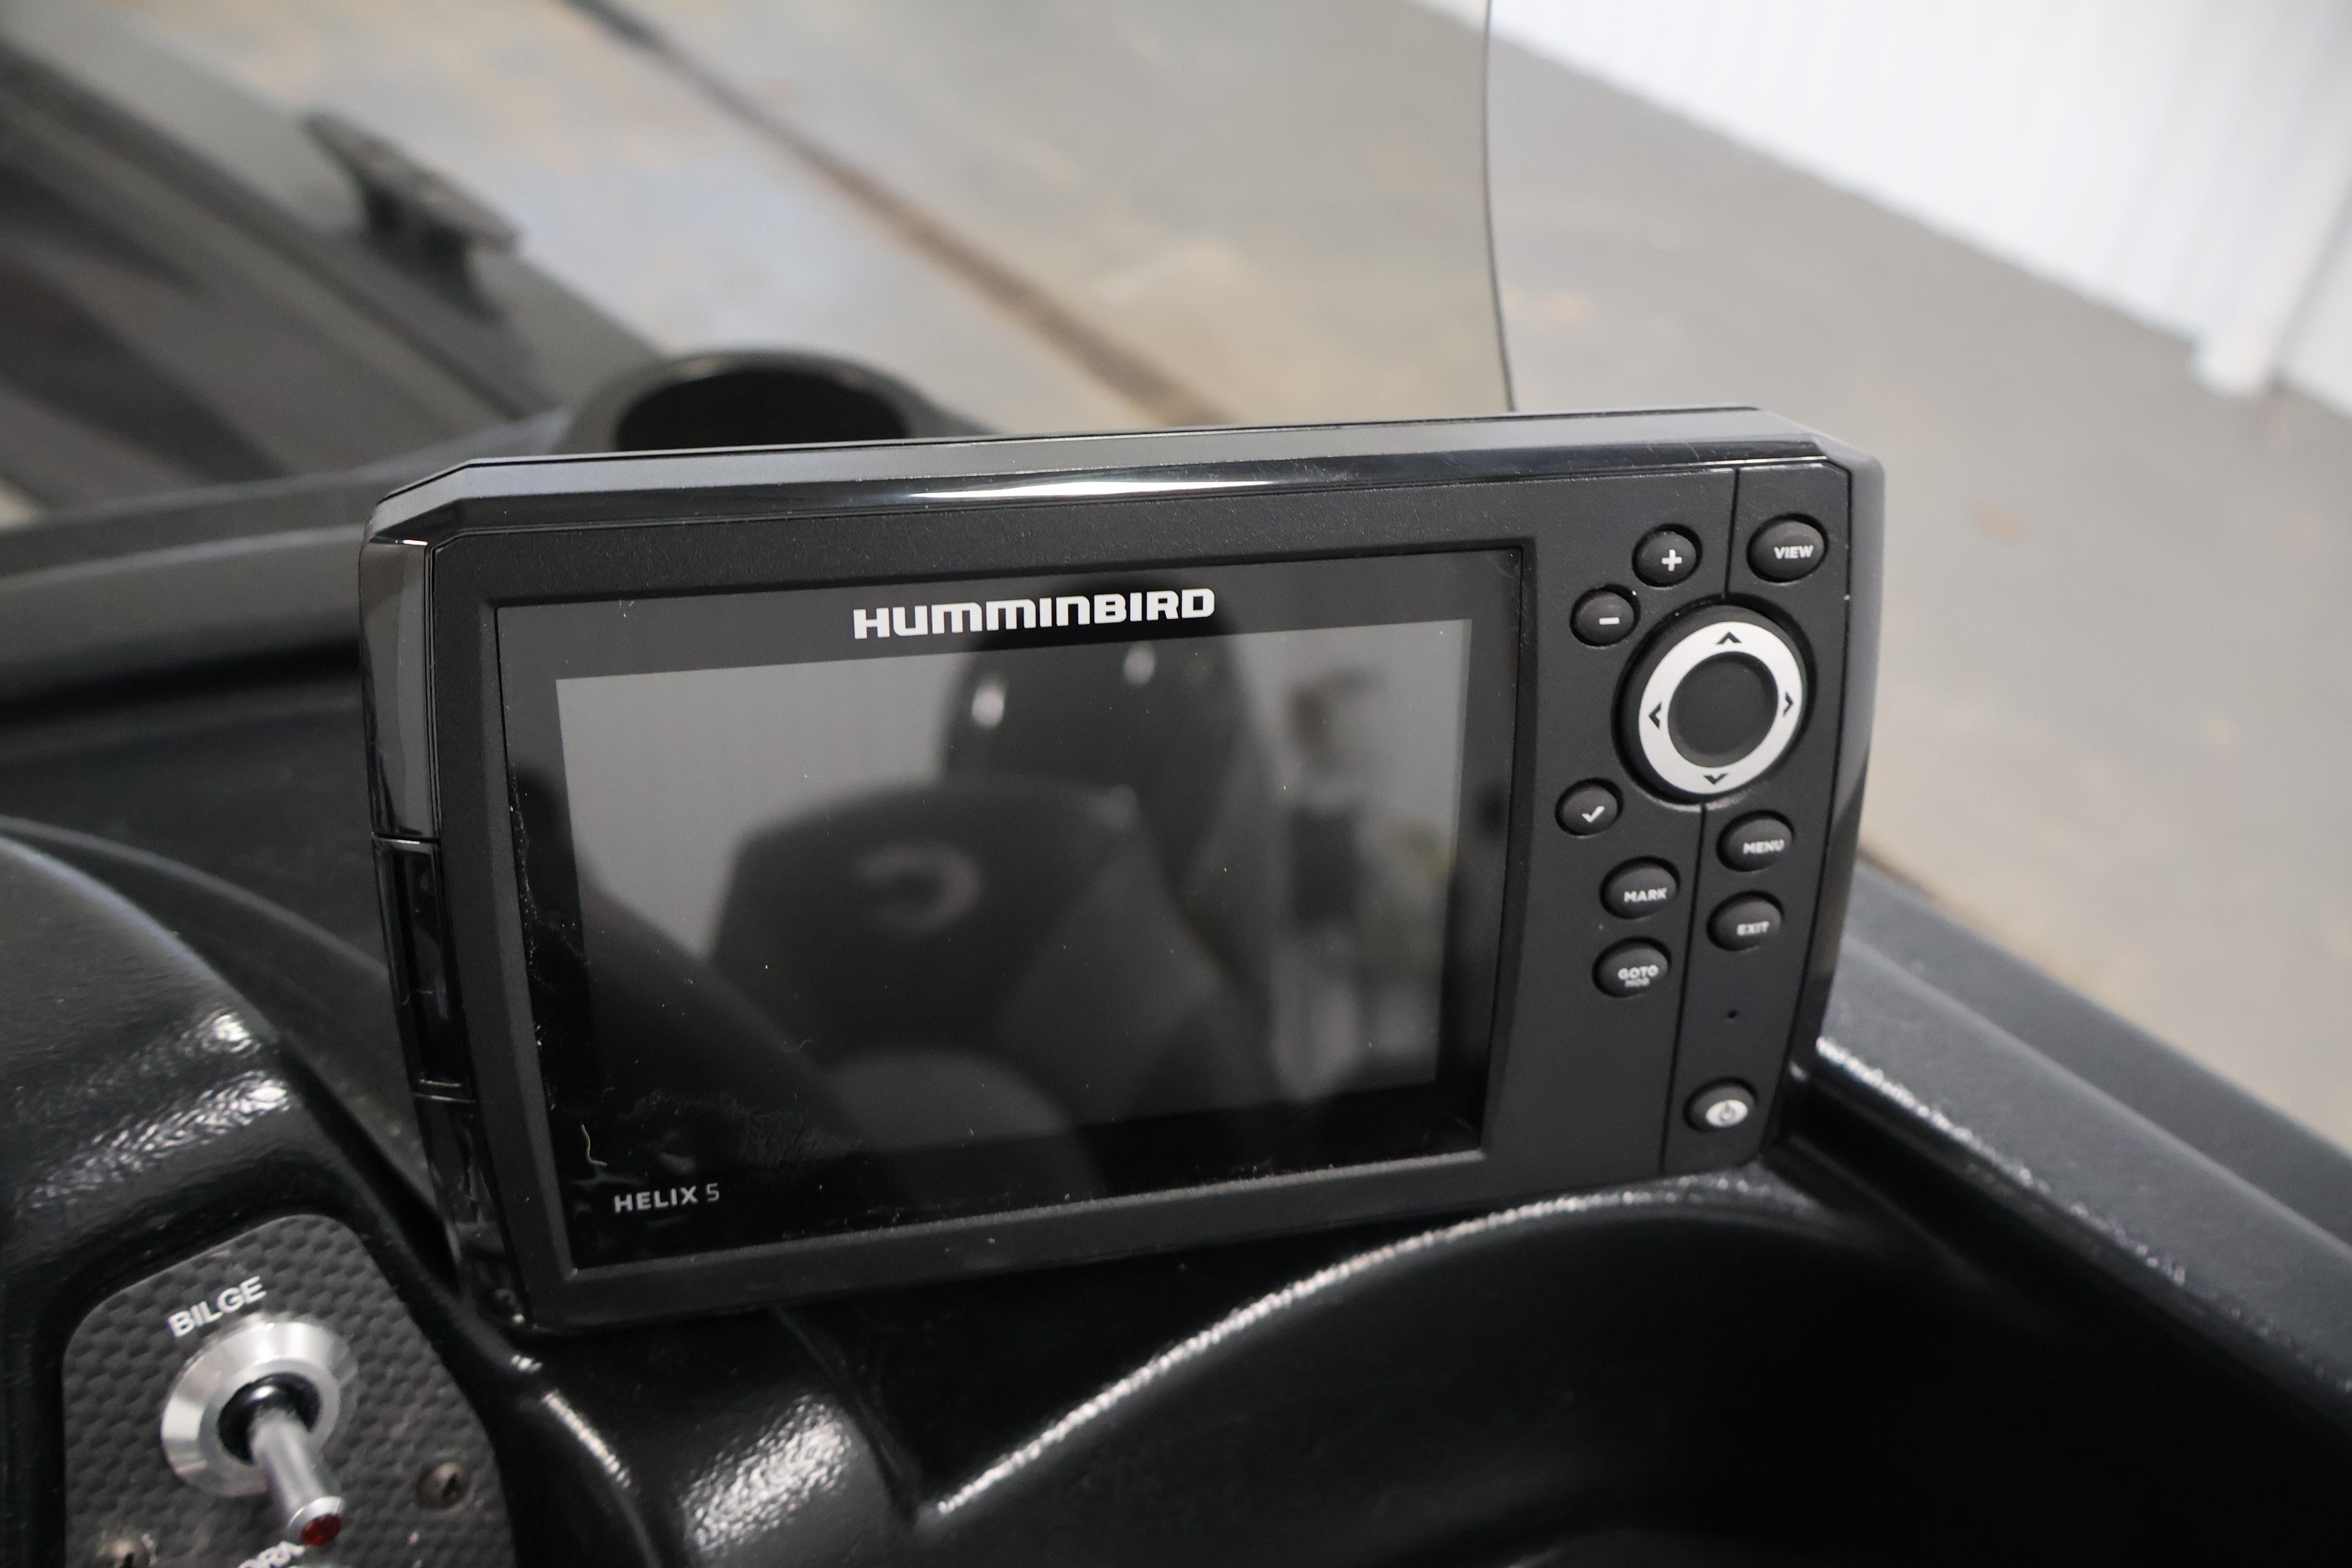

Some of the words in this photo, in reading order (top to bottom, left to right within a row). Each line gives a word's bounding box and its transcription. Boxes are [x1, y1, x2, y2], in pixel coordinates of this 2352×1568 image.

[1774, 544, 1814, 559] VIEW
[853, 588, 1215, 639] HUMMINBIRD
[1743, 839, 1785, 854] MENU
[1624, 887, 1667, 902] MARK
[1737, 920, 1770, 936] EXIT
[1618, 964, 1659, 980] GOTO
[614, 1185, 698, 1213] HELIX
[706, 1182, 720, 1202] 5
[168, 1275, 267, 1337] BILGE
